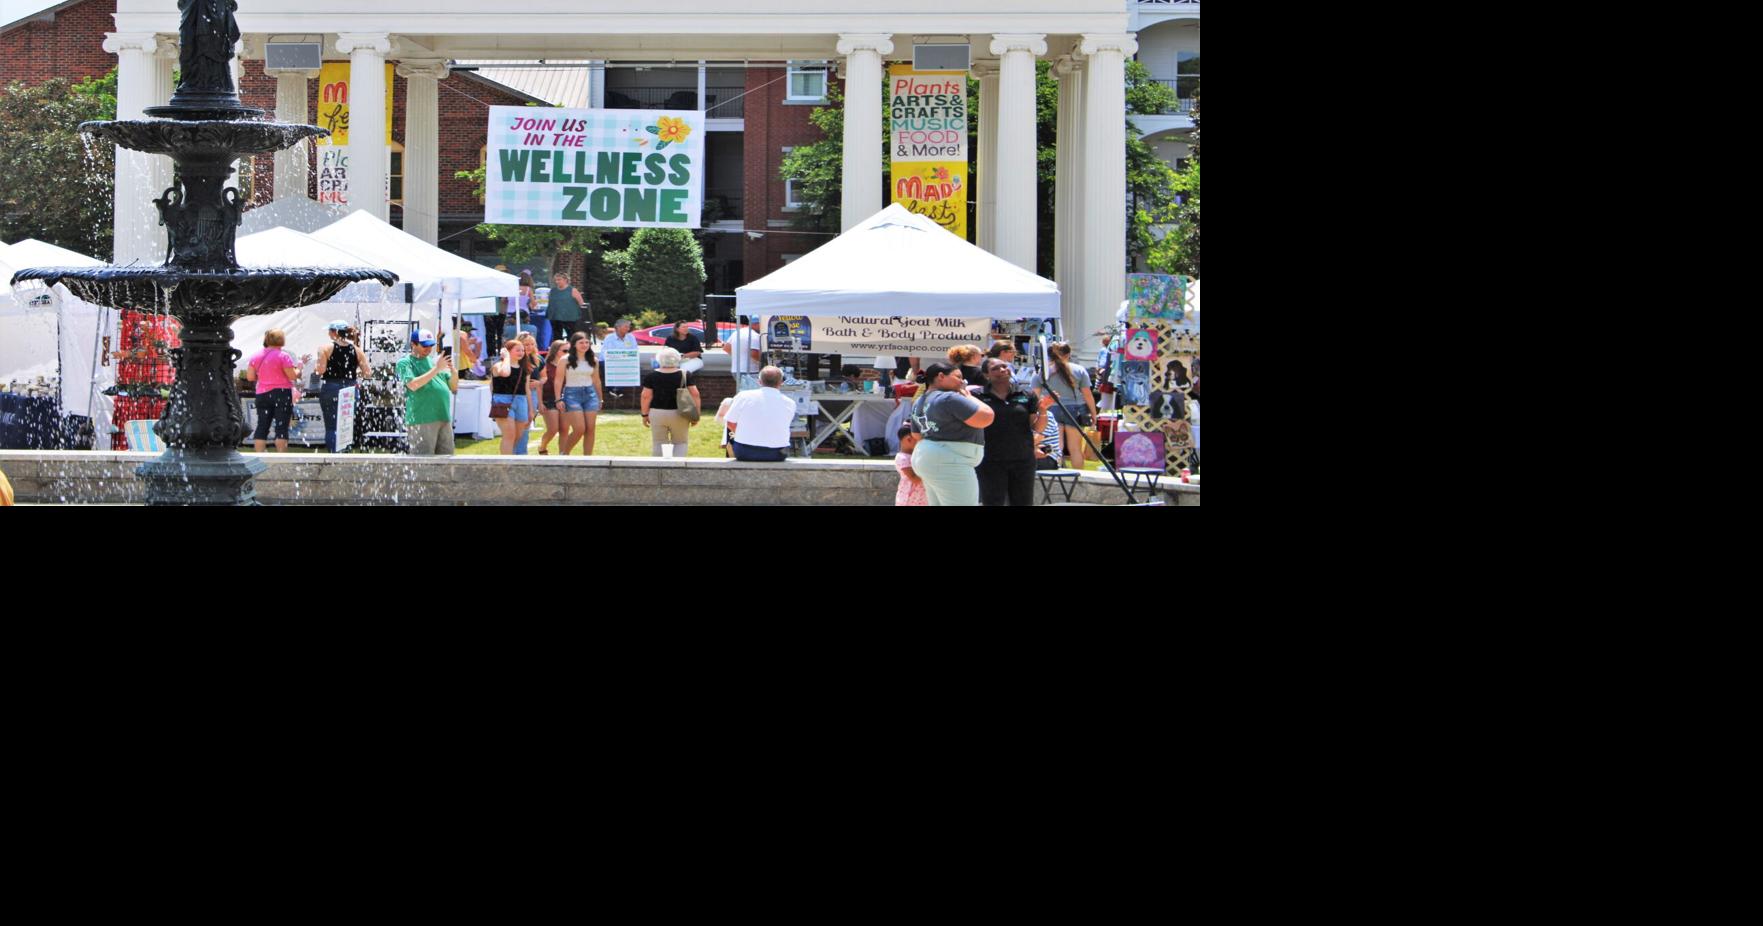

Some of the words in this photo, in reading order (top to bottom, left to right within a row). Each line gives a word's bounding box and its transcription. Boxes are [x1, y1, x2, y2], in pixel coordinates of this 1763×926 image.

[895, 79, 960, 96] Plants
[892, 107, 964, 119] CRAFTS
[510, 117, 556, 131] JOIN
[561, 118, 588, 132] US
[892, 119, 964, 131] MUSIC
[523, 132, 545, 146] IN
[552, 133, 588, 147] THE
[899, 131, 959, 144] FOOD
[897, 144, 909, 157] &
[912, 144, 961, 157] More!
[498, 149, 691, 186] WELLNESS
[561, 186, 689, 223] ZONE
[838, 316, 893, 325] Natural
[896, 316, 930, 327] Goat
[934, 318, 966, 328] Milk
[822, 327, 857, 337] Bath
[861, 328, 873, 338] &
[877, 329, 916, 341] Body
[919, 330, 982, 341] Products
